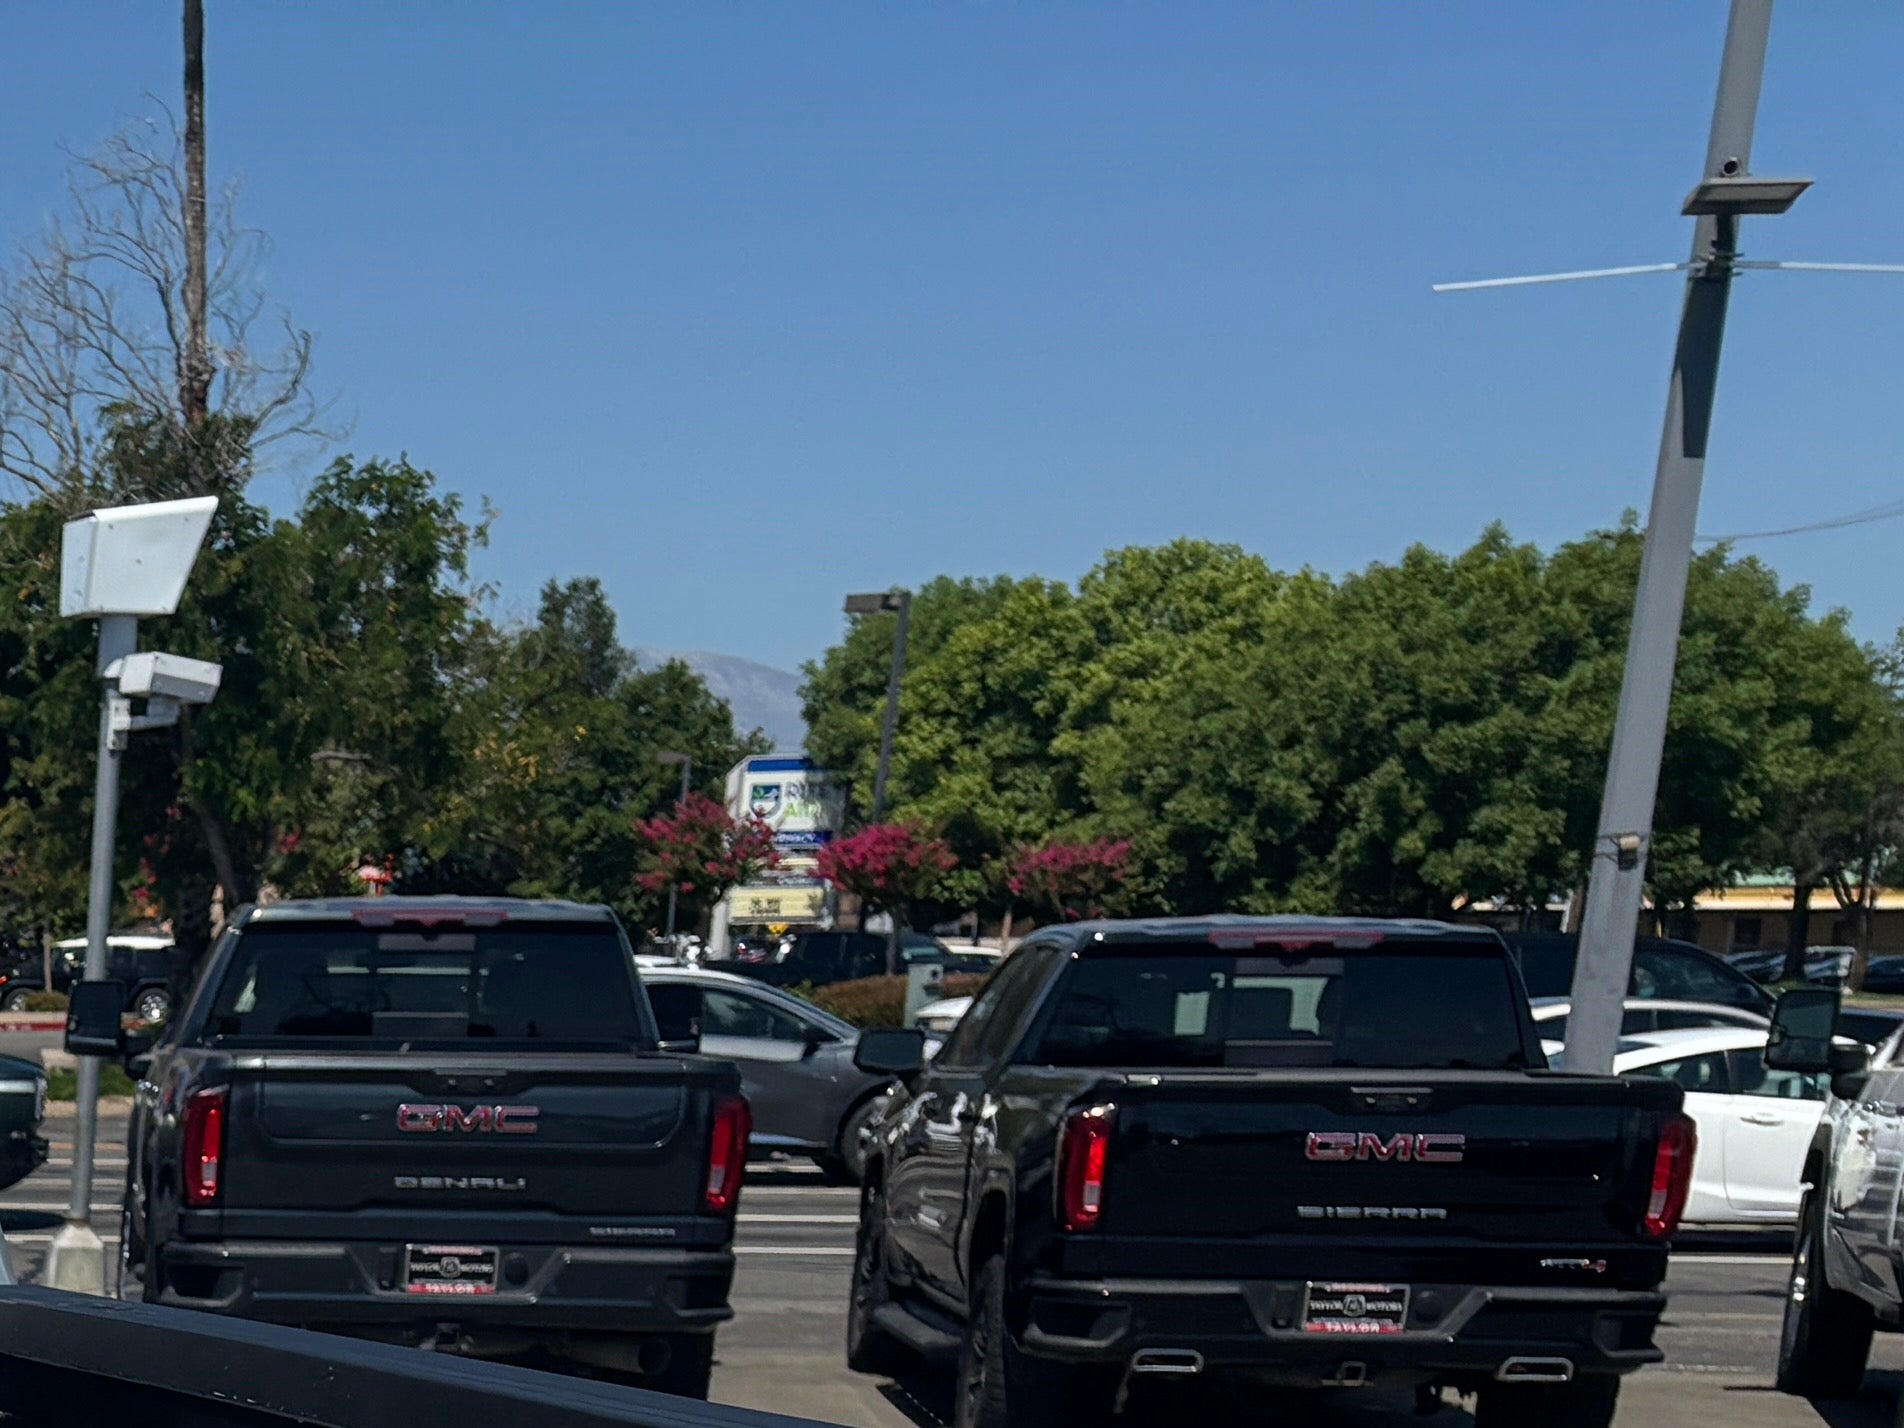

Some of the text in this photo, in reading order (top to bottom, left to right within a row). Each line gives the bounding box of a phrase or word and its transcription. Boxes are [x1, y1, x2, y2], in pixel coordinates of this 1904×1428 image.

[397, 1103, 539, 1134] GMC
[1304, 1132, 1465, 1162] GMC
[394, 1176, 526, 1190] DENALI
[1297, 1205, 1447, 1219] SIERRA
